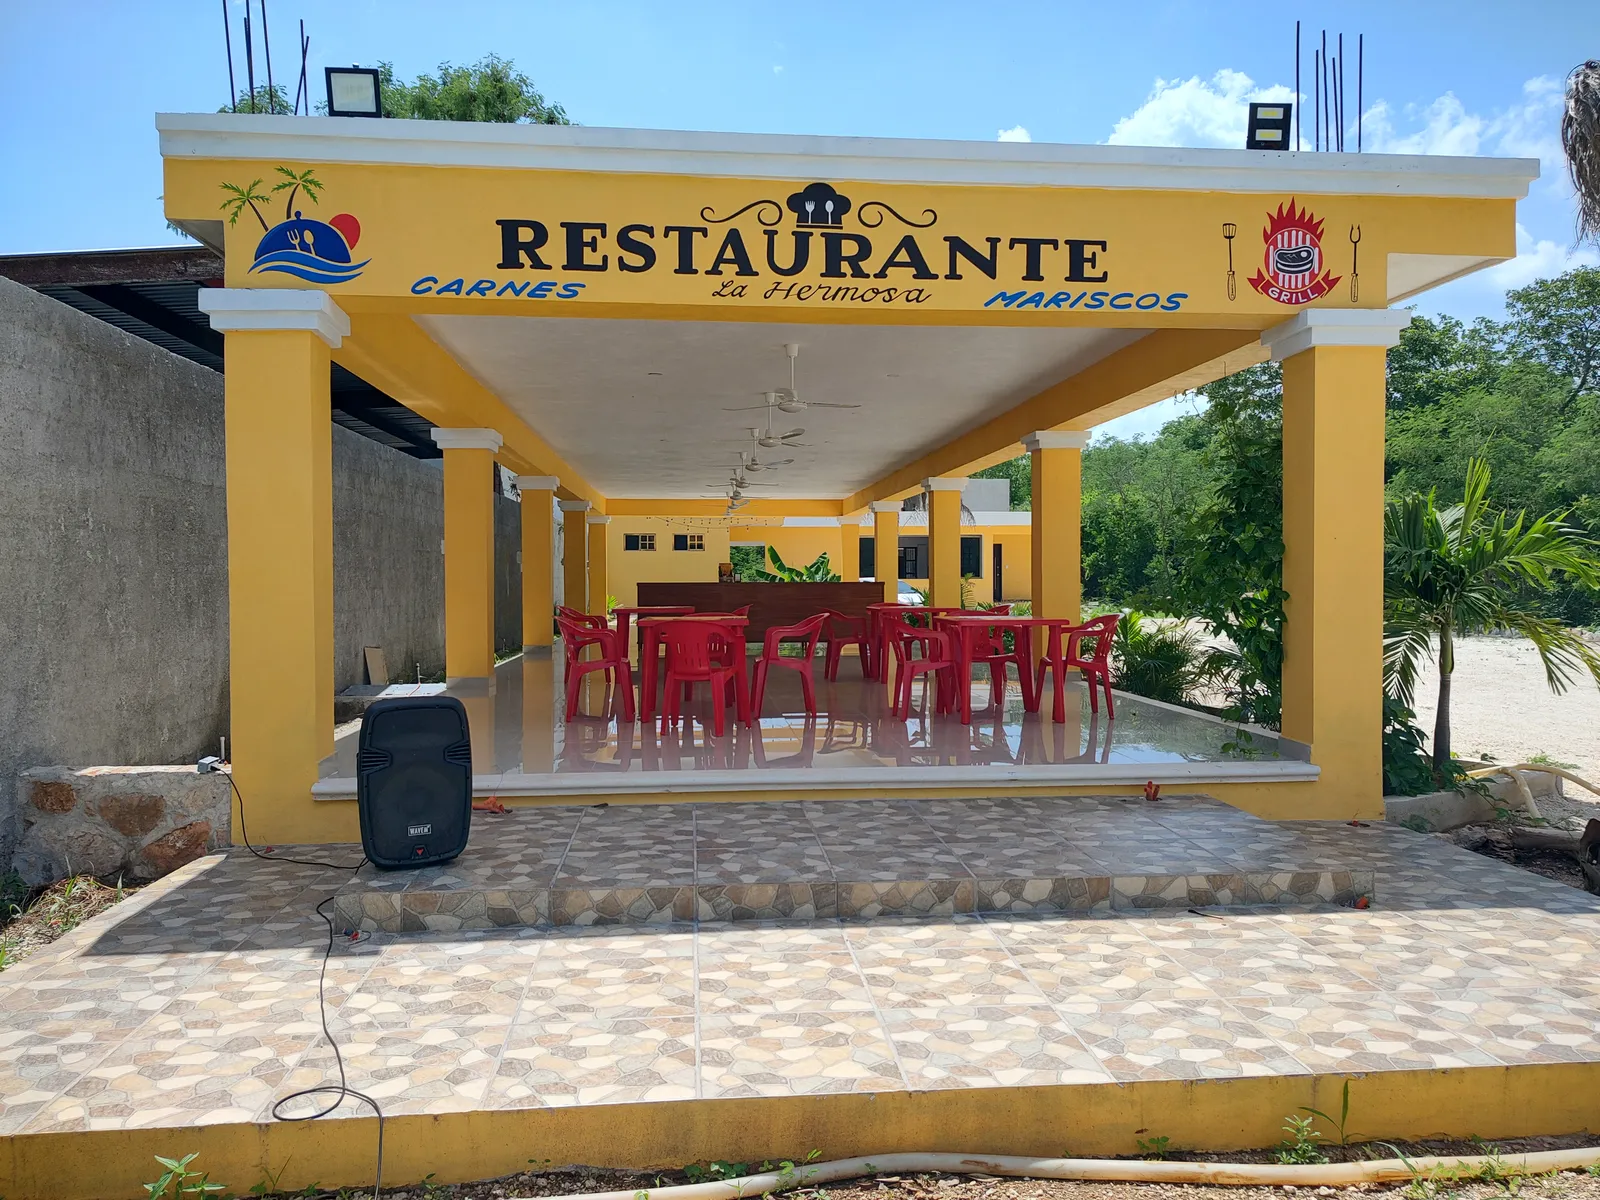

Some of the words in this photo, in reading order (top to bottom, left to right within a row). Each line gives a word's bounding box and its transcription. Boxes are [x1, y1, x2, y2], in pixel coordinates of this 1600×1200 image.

[496, 219, 1108, 282] RESTAURANTE
[410, 276, 586, 299] CARNES
[712, 279, 748, 298] La
[764, 281, 932, 304] Hermosa
[1268, 287, 1318, 304] GRILL
[984, 291, 1188, 311] MARISCOS
